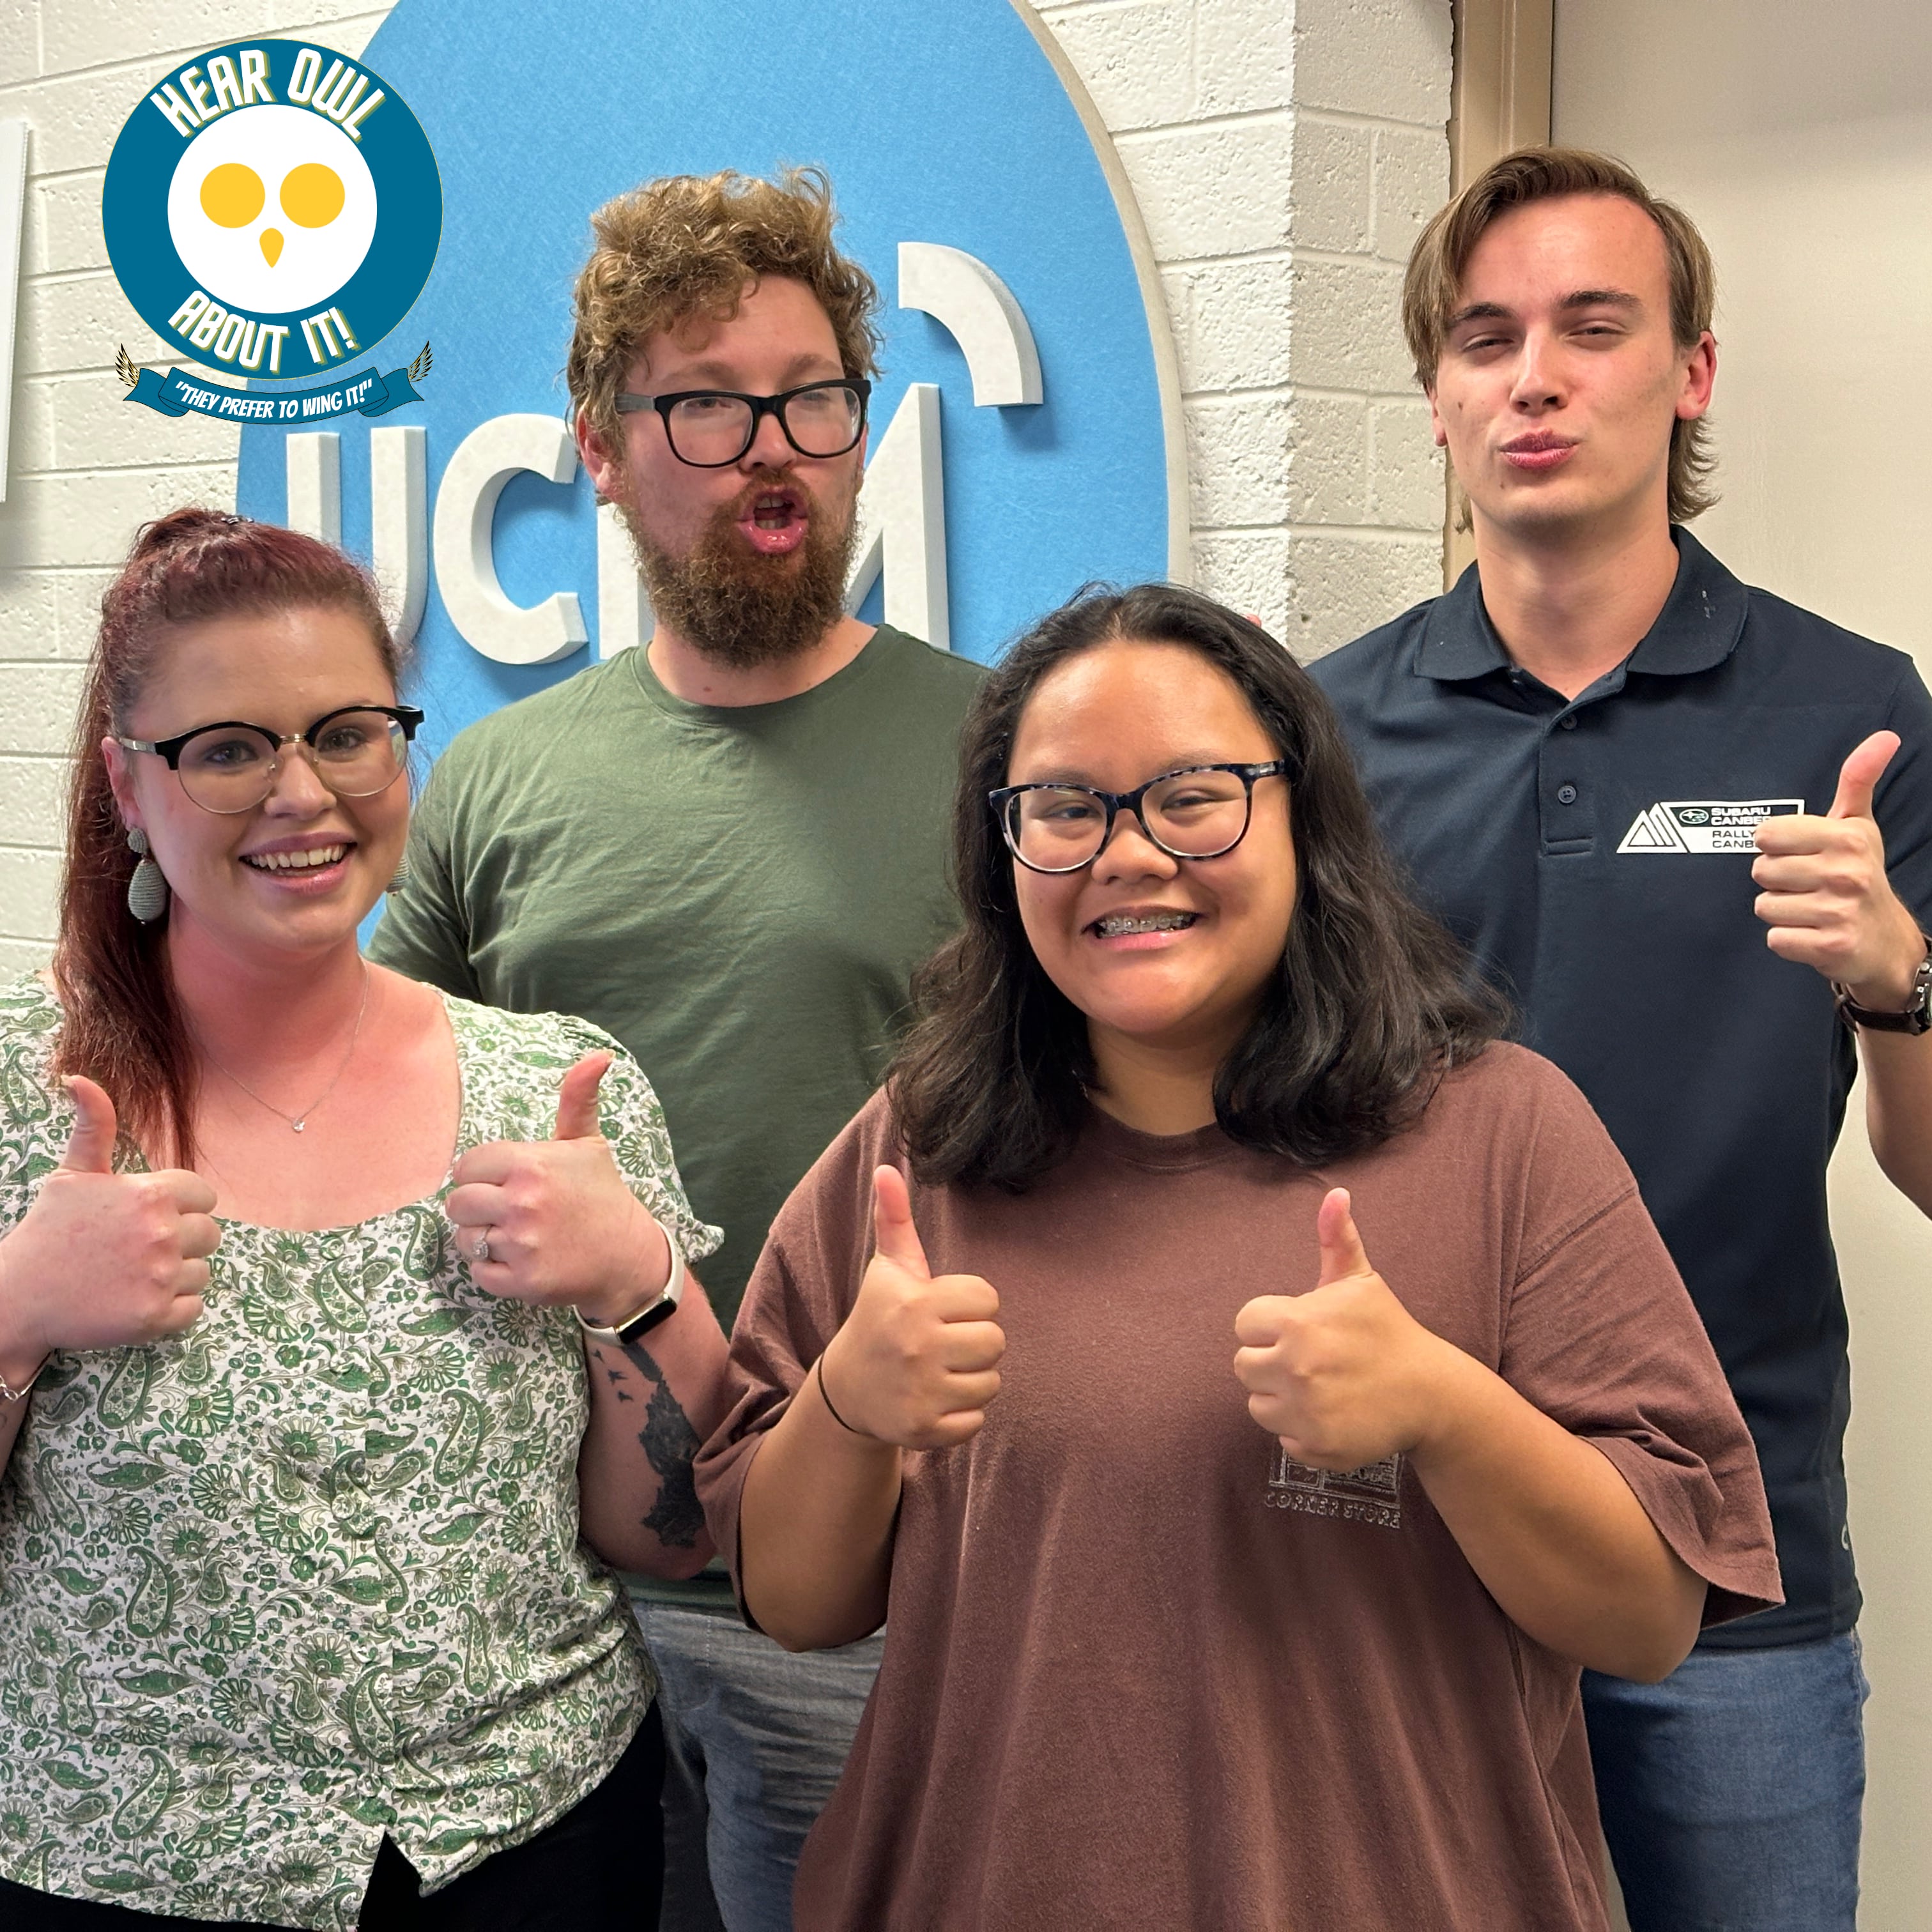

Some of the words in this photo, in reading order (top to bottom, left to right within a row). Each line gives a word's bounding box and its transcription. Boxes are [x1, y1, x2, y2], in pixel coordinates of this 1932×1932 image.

[1711, 806, 1771, 816] SUBARU
[1264, 1491, 1340, 1518] CORNER
[1344, 1502, 1400, 1529] STORE
